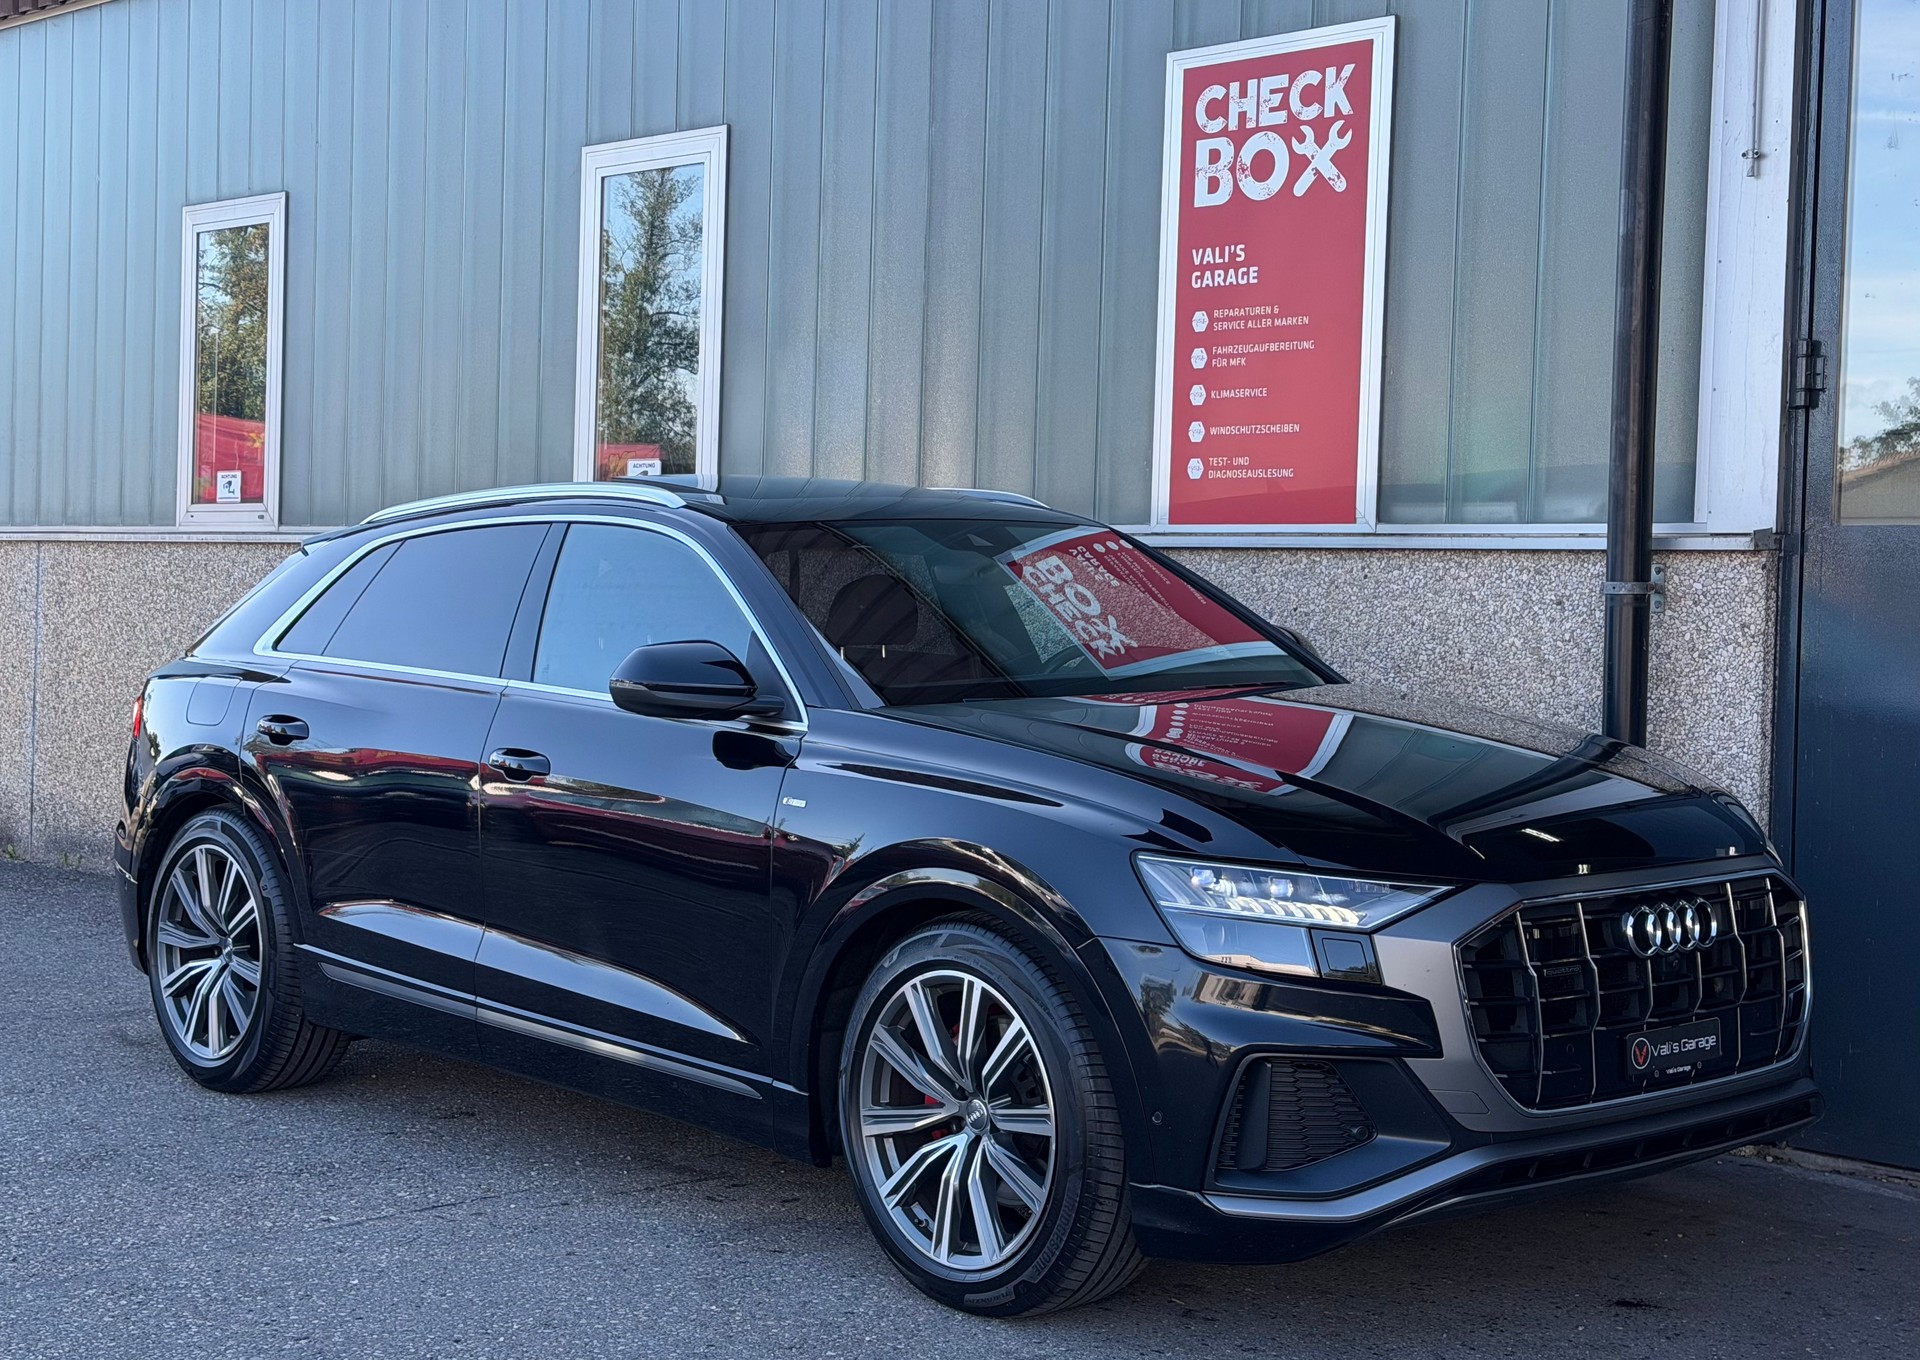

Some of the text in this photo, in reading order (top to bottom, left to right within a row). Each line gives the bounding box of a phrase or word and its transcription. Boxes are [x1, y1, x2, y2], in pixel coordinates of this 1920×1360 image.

[1195, 64, 1356, 134] CHECK
[1191, 244, 1246, 266] VALI'S
[1191, 266, 1259, 289] GARAGE
[1213, 305, 1280, 318] REPARATUREN &
[1213, 316, 1309, 331] SERVICE ALLER MARKEN
[1212, 340, 1315, 355] FAHRZEUGAUFBEREITUNG
[1212, 357, 1247, 368] FÜR MFK
[1210, 388, 1267, 399] KLIMASERVICE
[1209, 424, 1300, 435] WINDSCHUTZSCHEIBEN
[633, 462, 656, 470] ACHTUNG
[1208, 456, 1250, 466] TEST- UND
[1208, 468, 1294, 479] DIAGNOSEAUSLESUNG
[1651, 1041, 1680, 1057] Vali's
[1681, 1035, 1717, 1051] Garage
